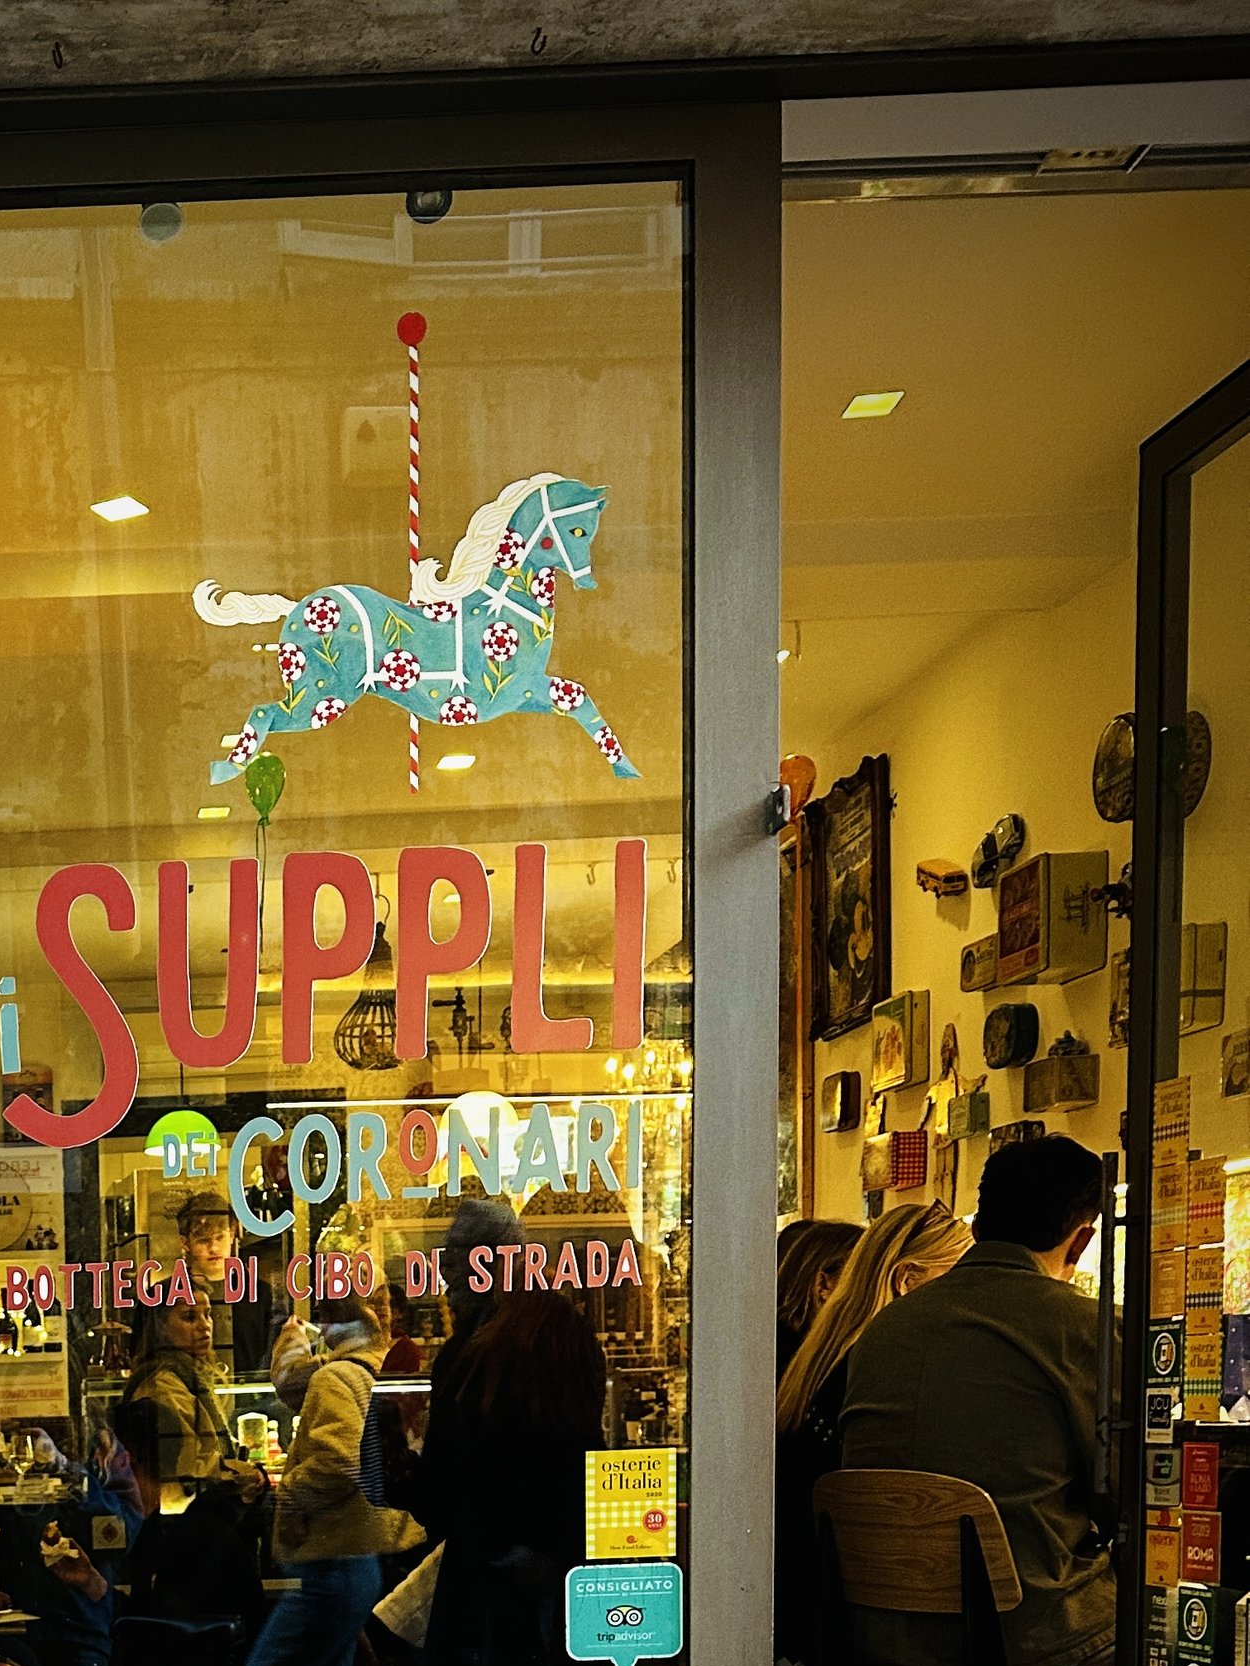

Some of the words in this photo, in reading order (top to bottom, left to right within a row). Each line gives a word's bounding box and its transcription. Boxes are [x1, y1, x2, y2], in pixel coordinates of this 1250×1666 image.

[2, 838, 647, 1149] SUPPLI
[229, 1101, 643, 1238] CORONARI
[5, 1257, 196, 1312] BOTTEGA
[224, 1256, 259, 1304] DI
[285, 1250, 375, 1303] CIBO
[405, 1248, 443, 1298] DI
[469, 1239, 644, 1293] STRADA
[601, 1456, 661, 1472] osterie
[602, 1472, 662, 1490] d'Italia
[647, 1513, 662, 1523] 30
[1187, 1546, 1214, 1562] ROMA
[576, 1580, 673, 1593] CONSIGLIATO
[597, 1631, 654, 1643] tripadvisor
